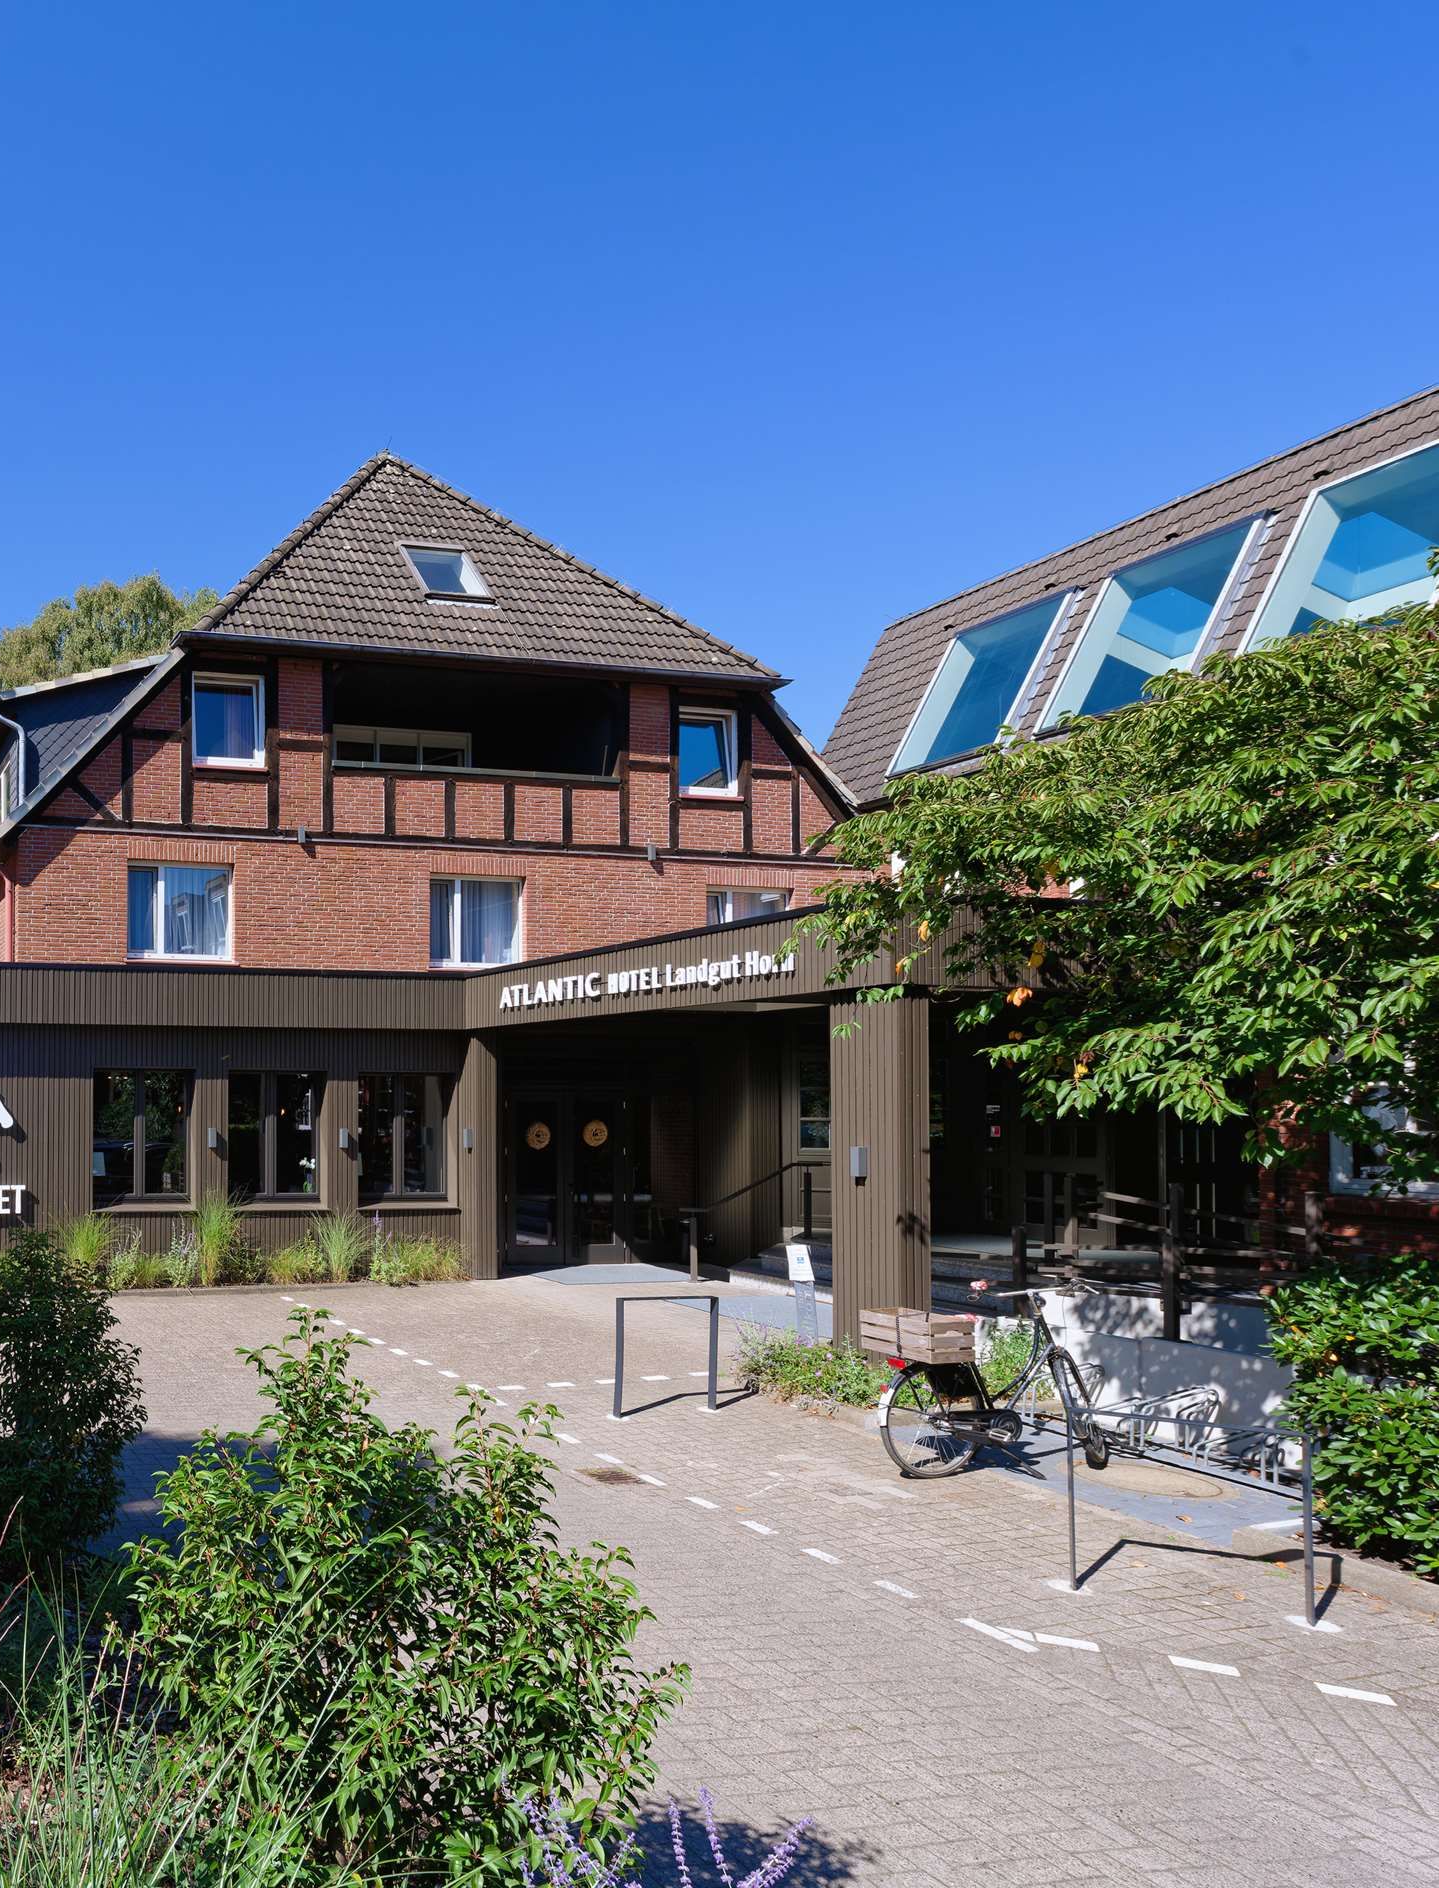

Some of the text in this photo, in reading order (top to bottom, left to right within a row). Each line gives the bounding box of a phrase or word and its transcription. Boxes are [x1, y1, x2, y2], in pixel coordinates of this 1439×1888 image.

[499, 972, 600, 1008] ATLANTIC
[607, 966, 663, 995] HOTEL
[665, 954, 742, 987] Landgut
